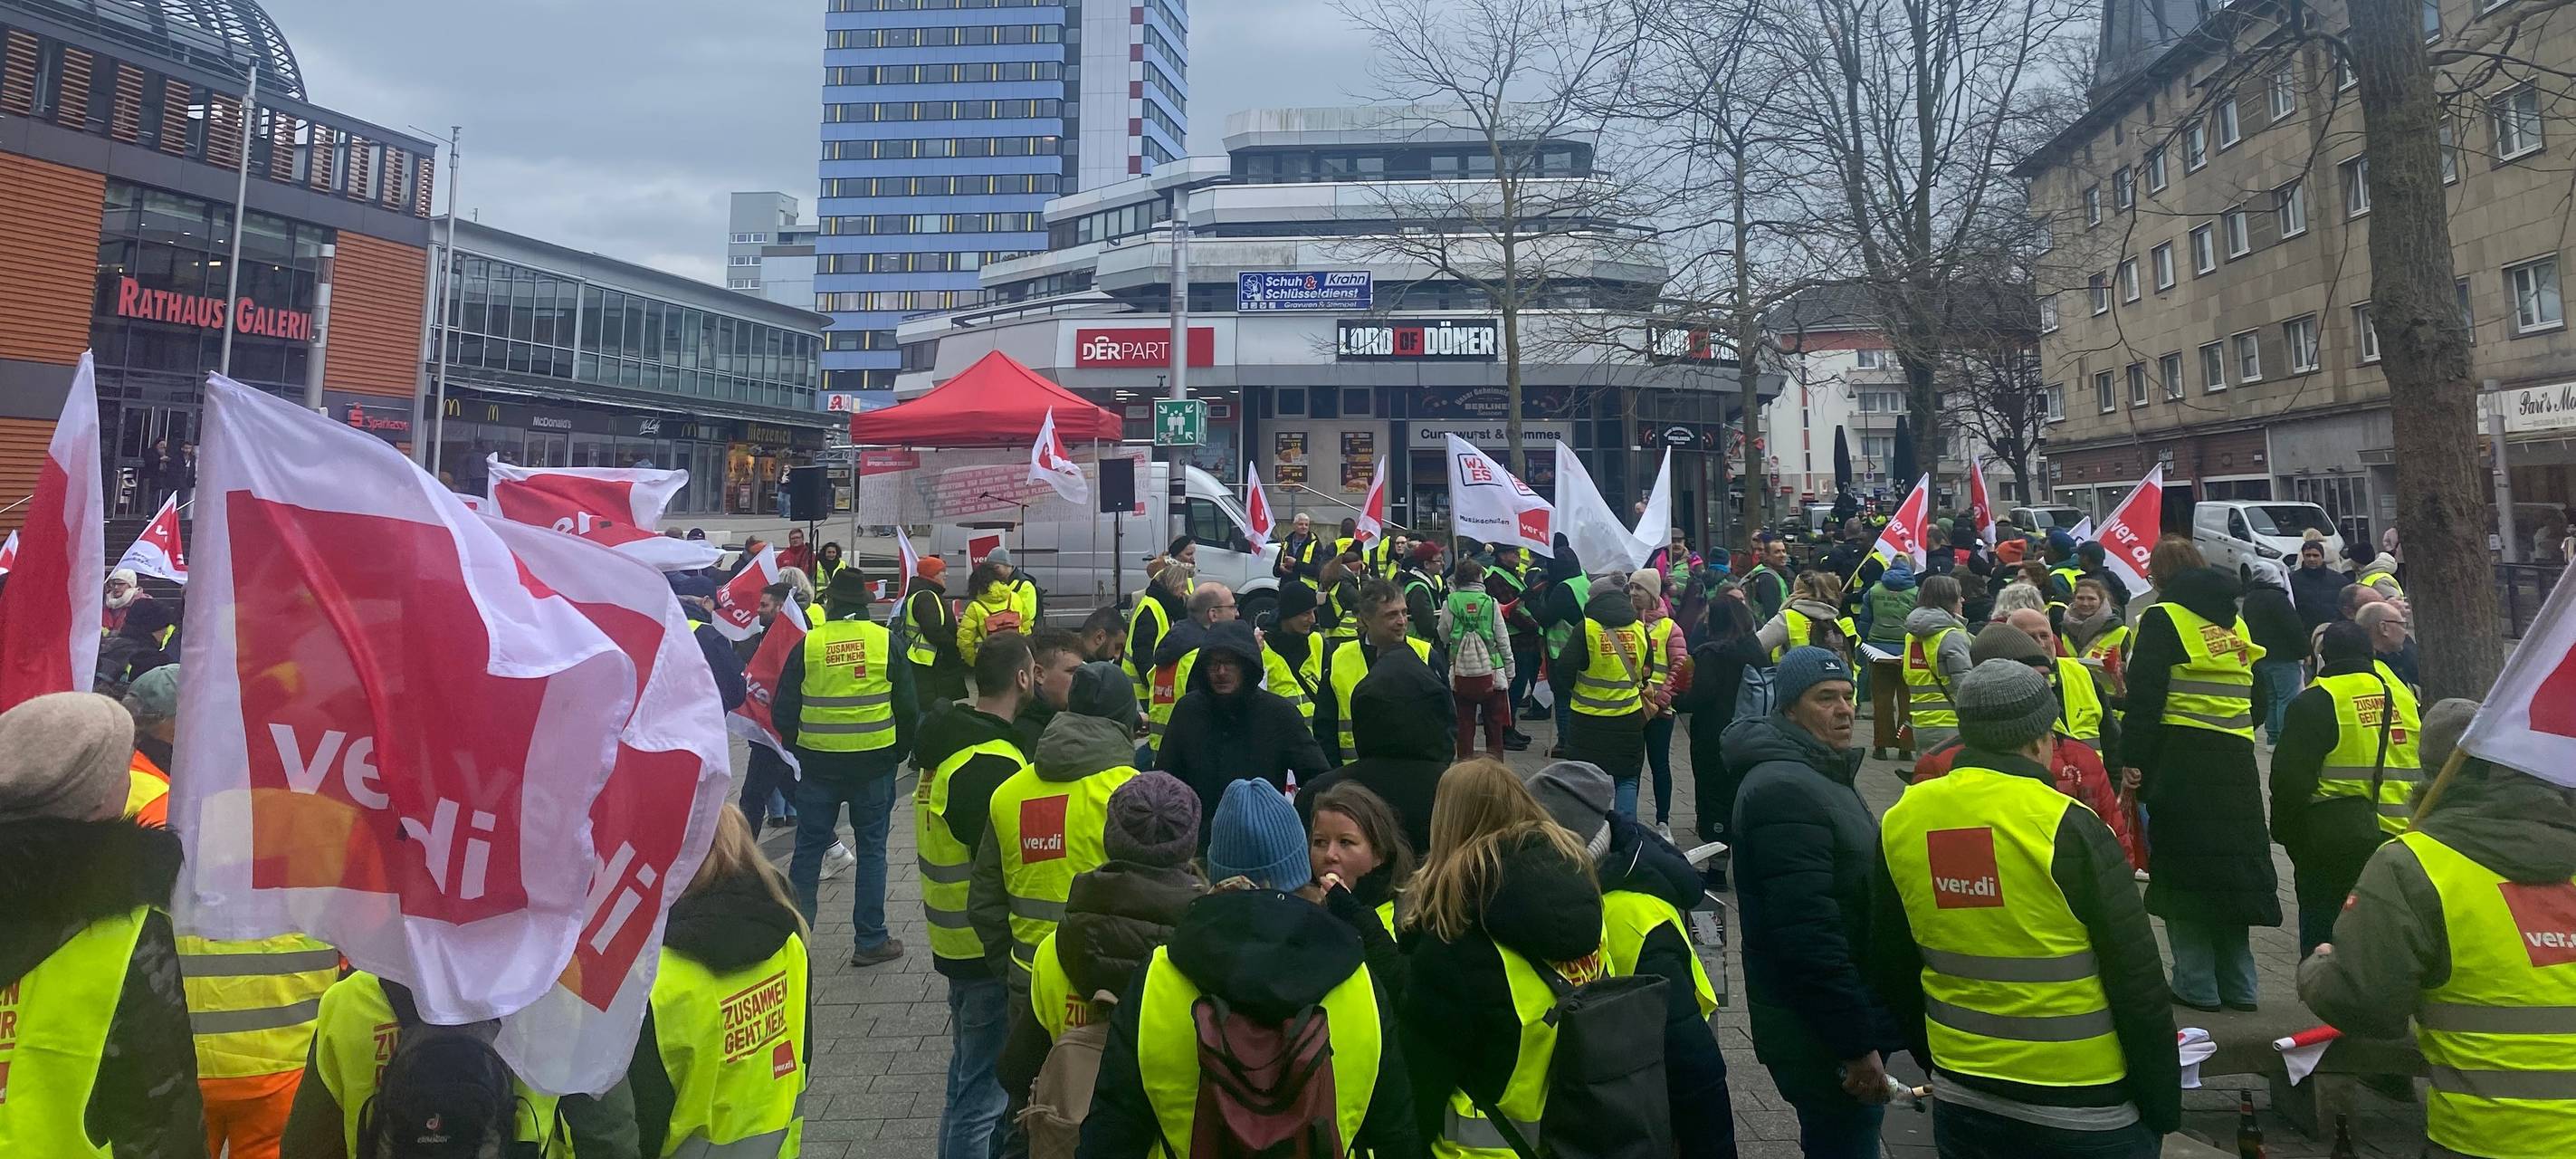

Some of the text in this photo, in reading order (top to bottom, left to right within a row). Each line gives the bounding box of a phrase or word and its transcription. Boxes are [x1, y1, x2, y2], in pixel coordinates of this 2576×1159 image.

[1265, 273, 1366, 290] Schuh & Krahn
[1265, 289, 1359, 300] Schlüsseldienst
[118, 275, 311, 341] RATHAUS GALERI
[1339, 321, 1495, 355] LORD OF DÖNER
[1083, 337, 1169, 360] DERPART
[532, 416, 572, 429] McDonald's
[1421, 428, 1491, 440] Currwurst
[1495, 430, 1504, 439] &
[1459, 514, 1510, 525] Musikschulen
[825, 642, 865, 655] ZUSAMMEN
[825, 651, 865, 664] GEHT MEHR
[1024, 834, 1062, 849] ver.di
[1936, 876, 1996, 896] ver.di
[722, 979, 787, 1030] ZUSAMMEN
[725, 1020, 762, 1054] GEHT
